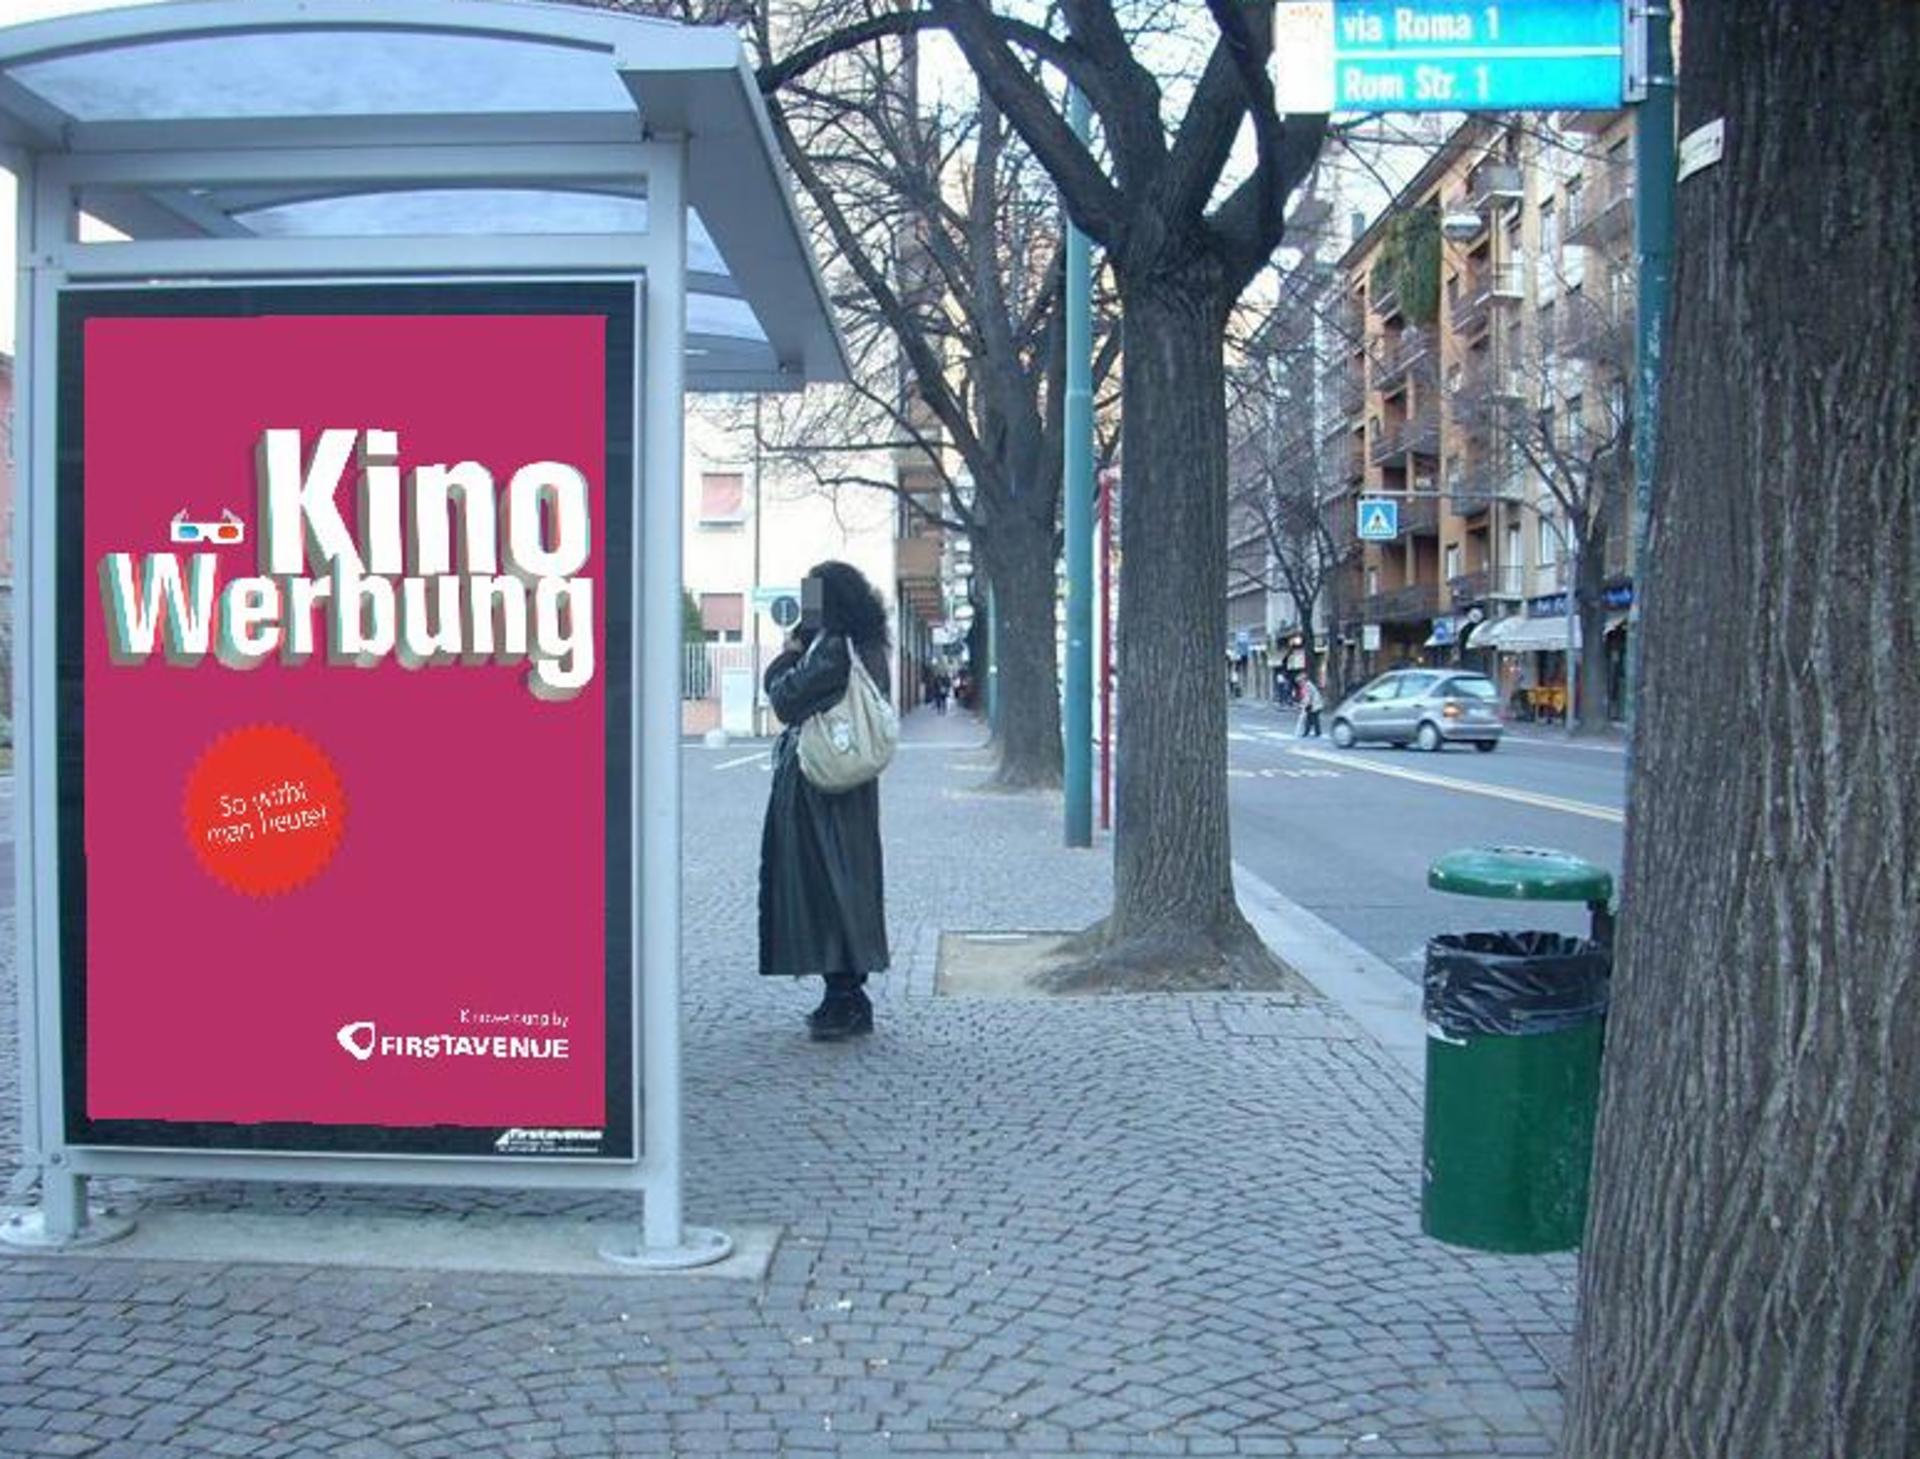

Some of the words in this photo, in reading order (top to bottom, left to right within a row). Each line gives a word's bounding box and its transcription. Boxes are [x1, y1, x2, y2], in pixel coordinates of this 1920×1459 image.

[1342, 9, 1383, 42] via
[1395, 8, 1473, 42] Roma
[1484, 6, 1500, 40] 1
[1344, 67, 1405, 101] Rom
[1415, 64, 1463, 100] Str.
[1474, 65, 1489, 101] 1
[256, 428, 592, 577] Kino
[98, 552, 596, 702] Werbung
[220, 795, 247, 818] So
[381, 1034, 569, 1058] FIRSTAVENUE
